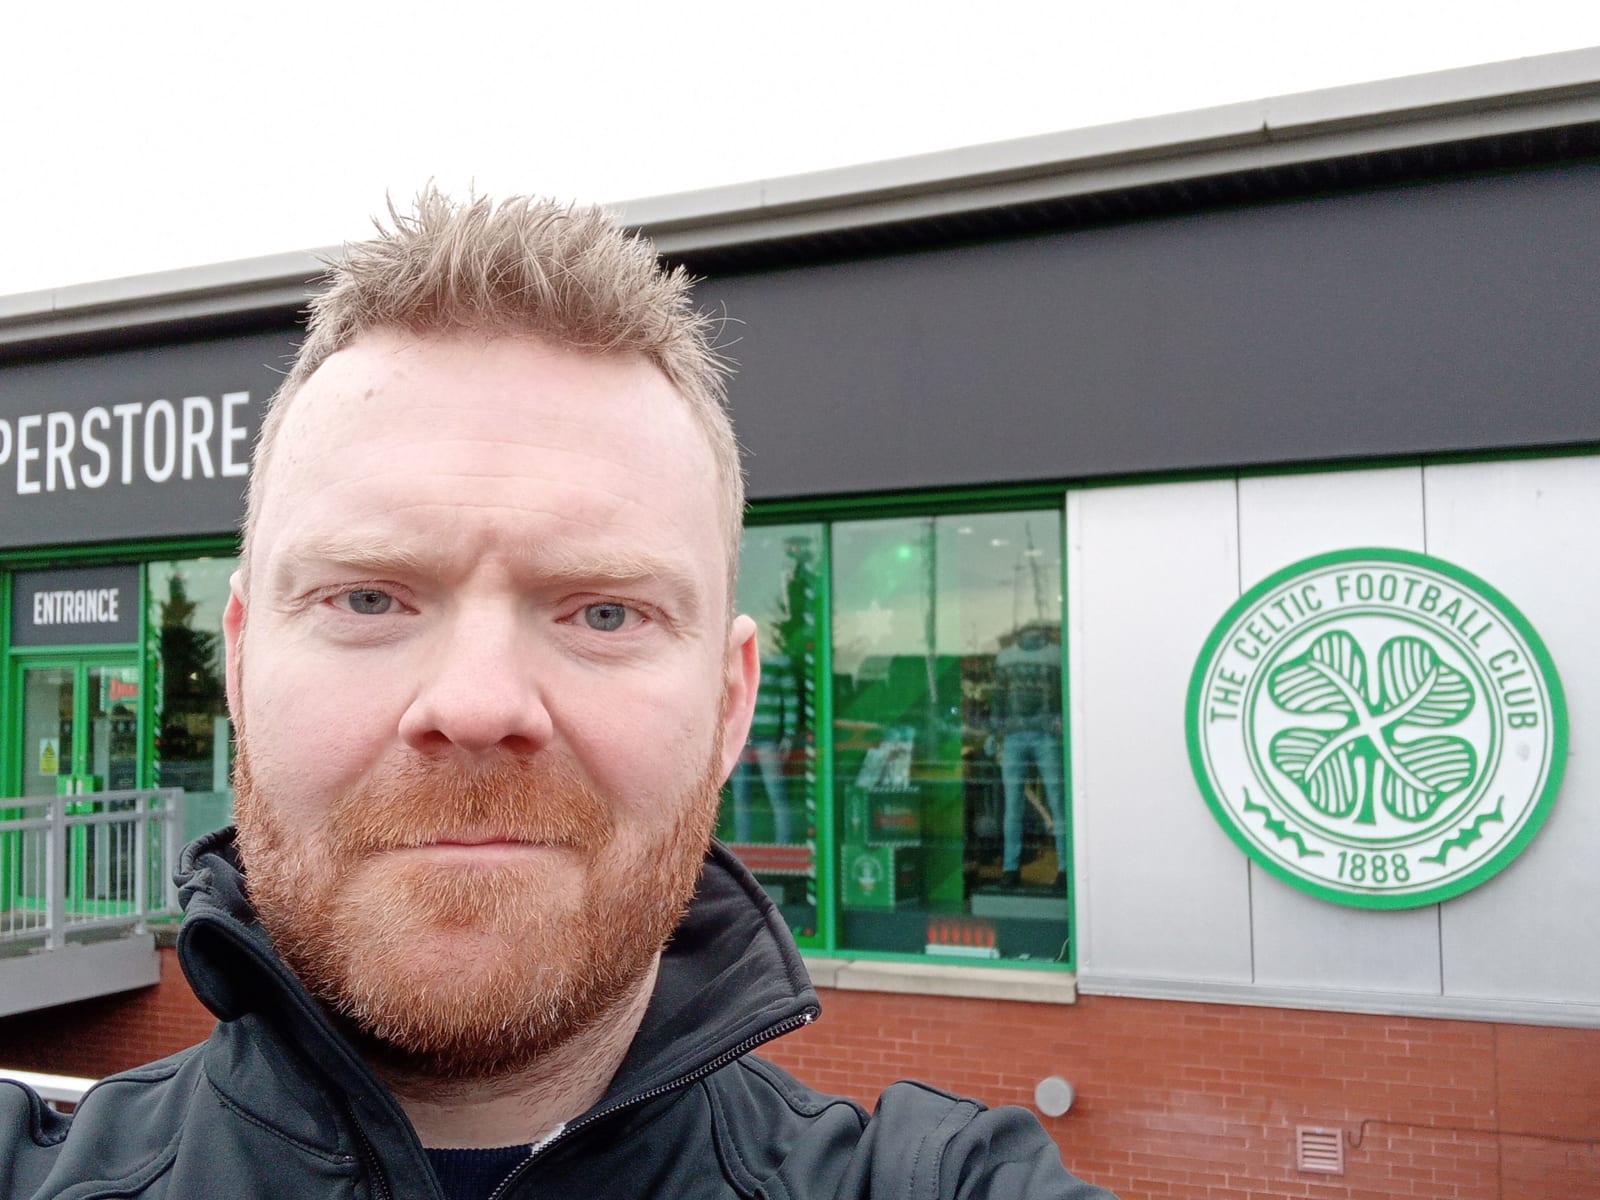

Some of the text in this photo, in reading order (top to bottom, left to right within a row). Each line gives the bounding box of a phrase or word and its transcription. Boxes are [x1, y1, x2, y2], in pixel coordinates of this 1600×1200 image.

[33, 588, 119, 624] ENTRANCE
[1210, 573, 1539, 729] THE CELTIC FOOTBALL CLUB
[1337, 851, 1410, 883] 1888
